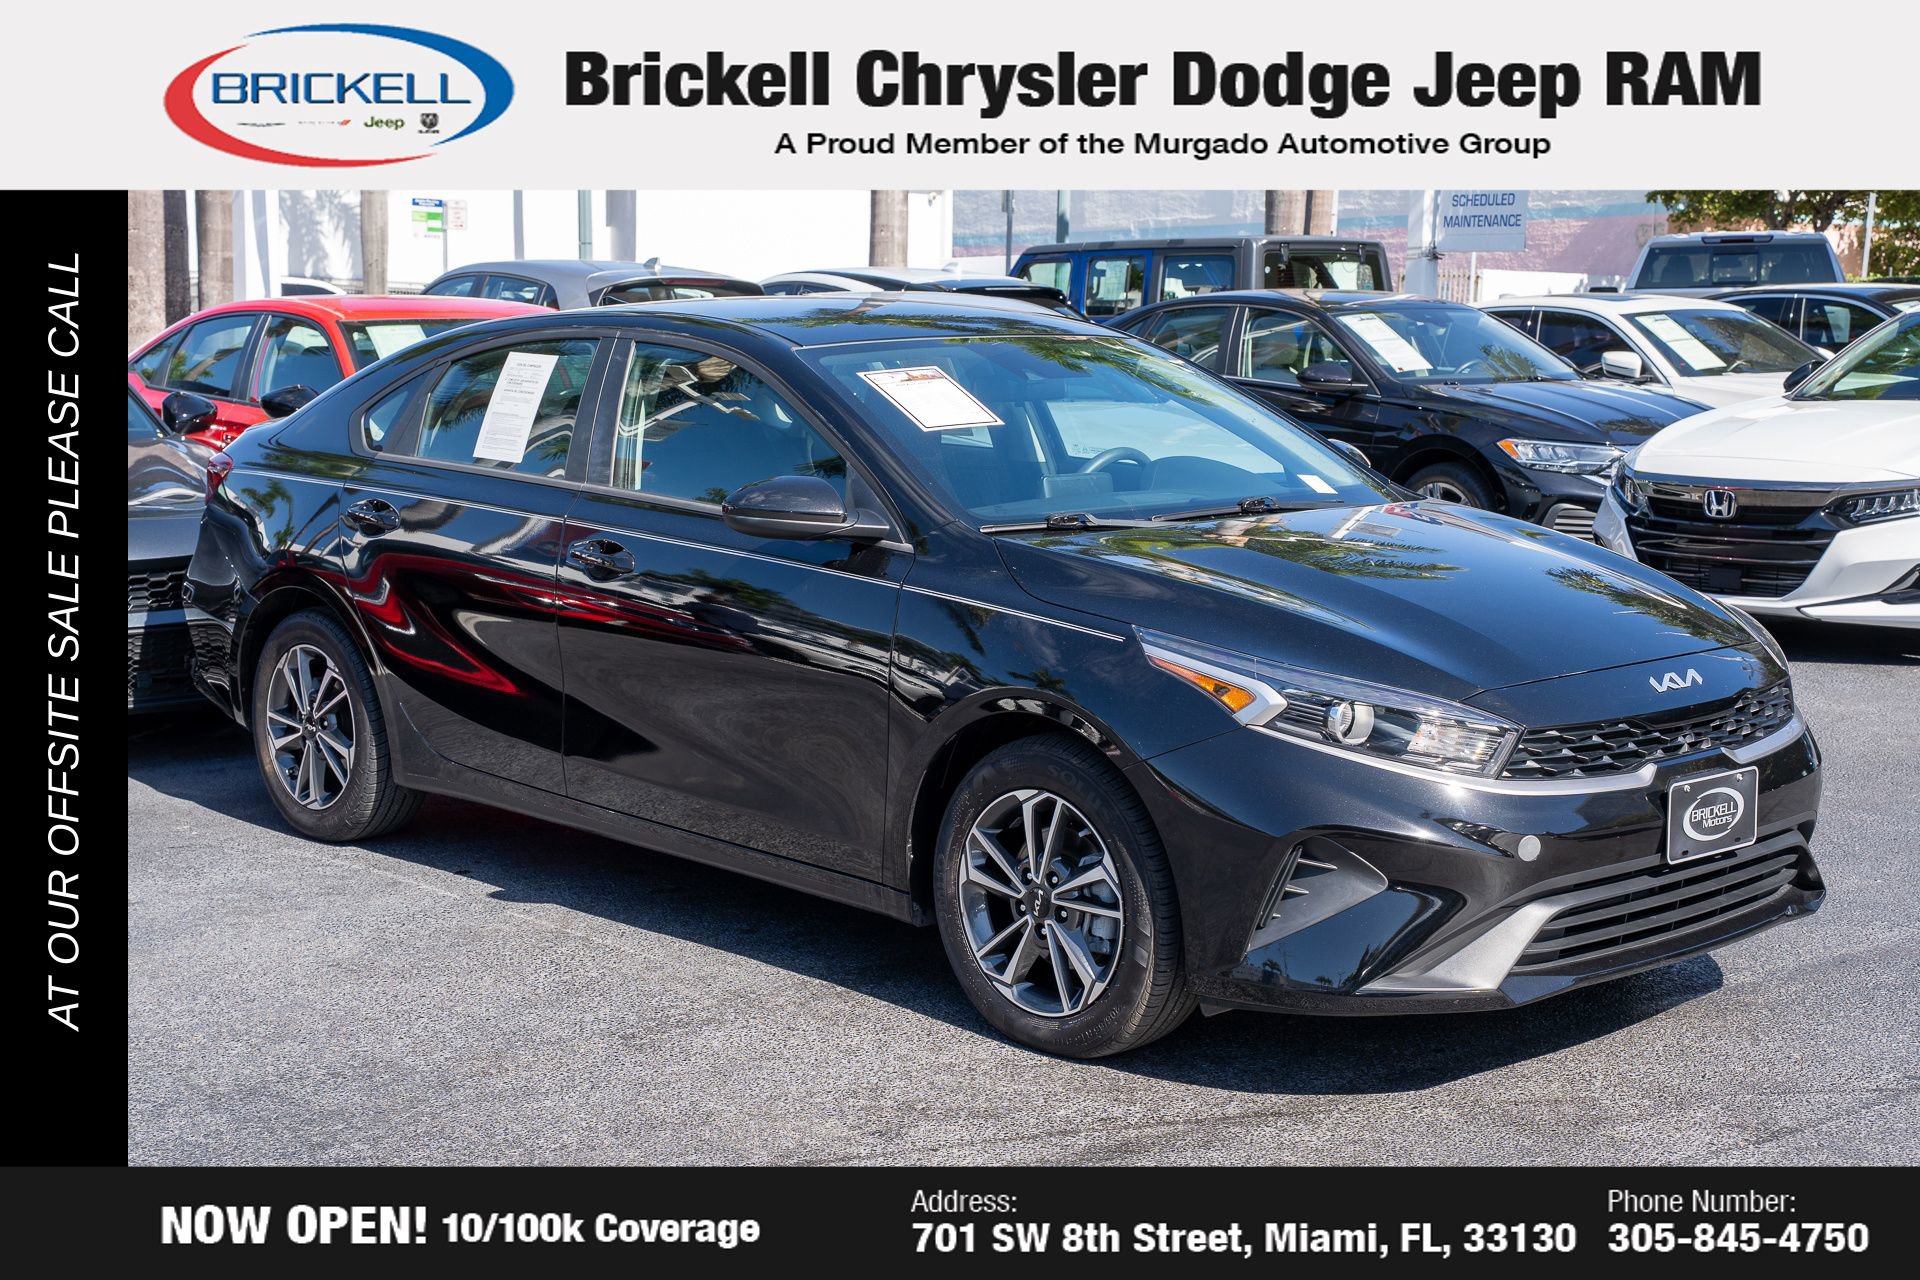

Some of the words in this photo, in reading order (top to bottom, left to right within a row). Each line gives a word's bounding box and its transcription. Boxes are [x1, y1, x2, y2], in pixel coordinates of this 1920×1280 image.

[1451, 193, 1516, 207] SCHEDULED
[1443, 214, 1522, 228] MAINTENANCE
[1691, 801, 1737, 823] BRICKELL
[1702, 814, 1733, 829] Motors
